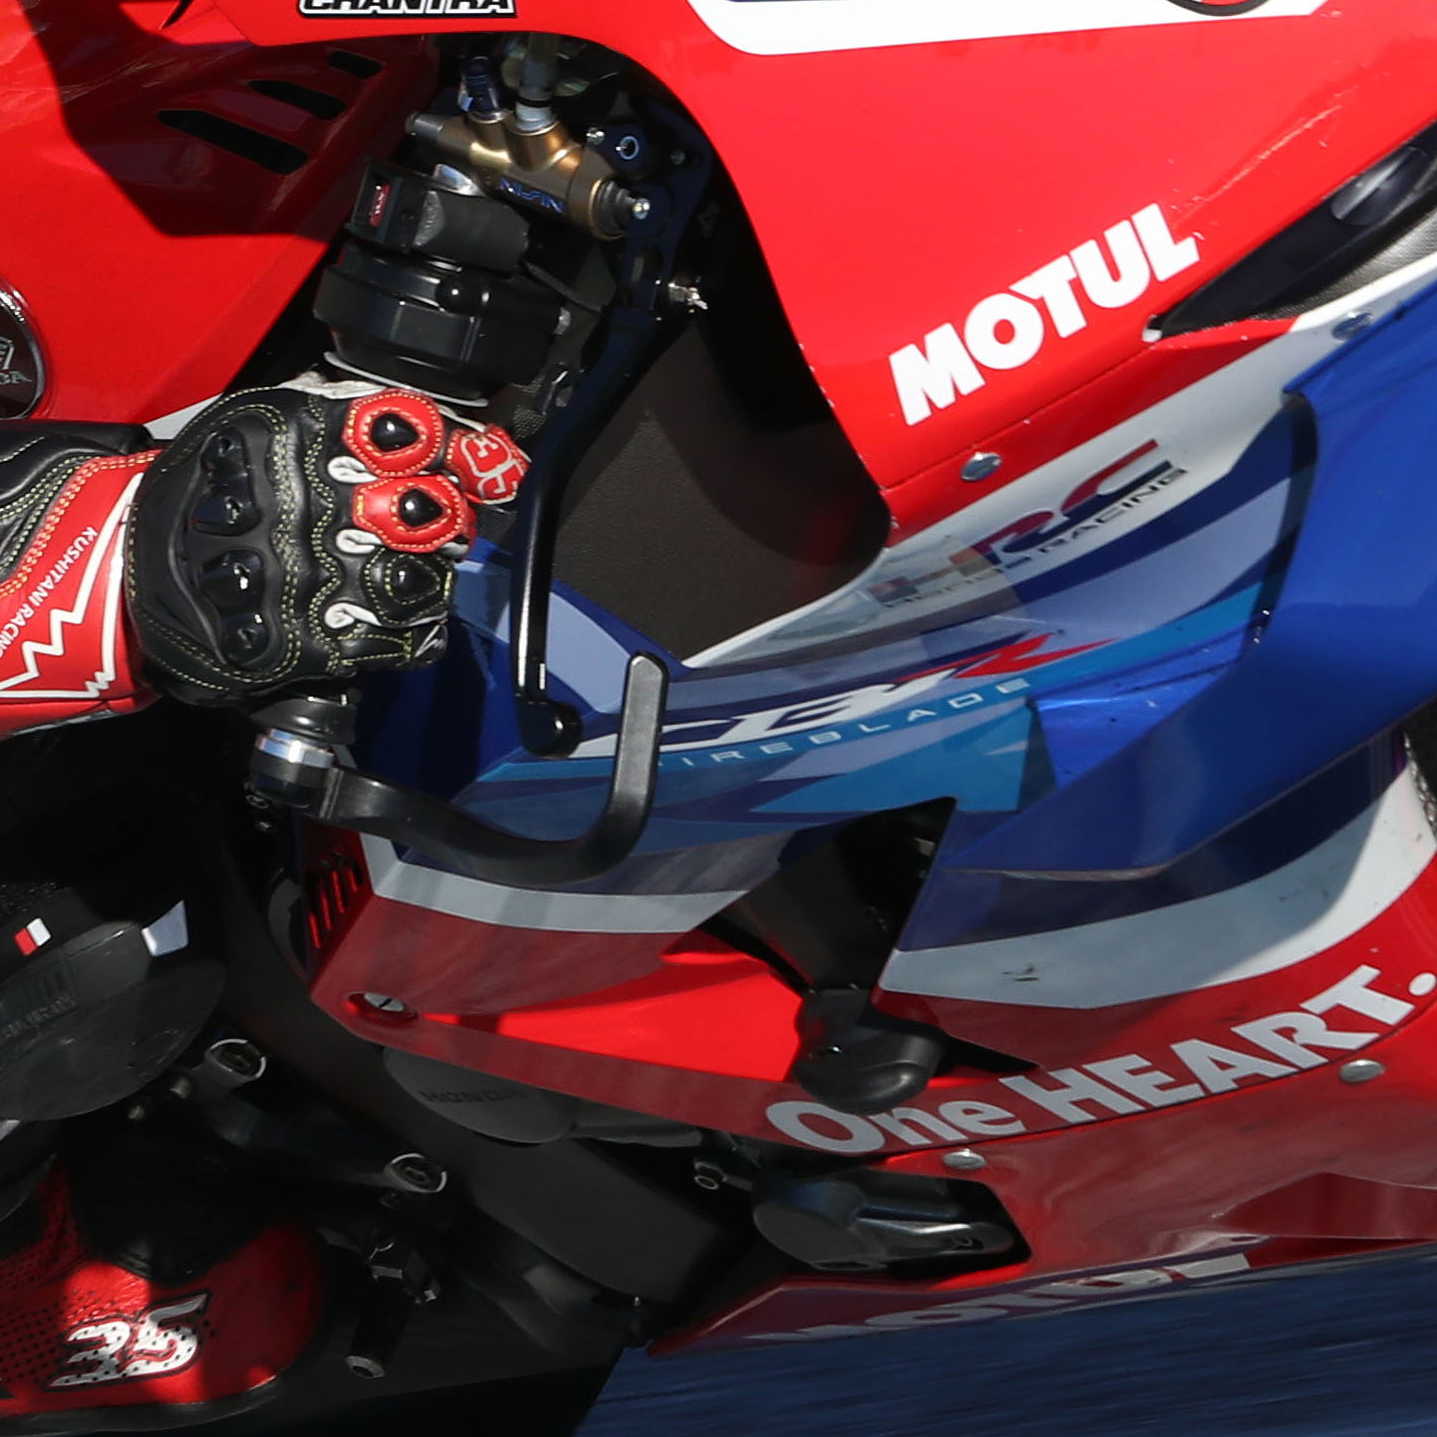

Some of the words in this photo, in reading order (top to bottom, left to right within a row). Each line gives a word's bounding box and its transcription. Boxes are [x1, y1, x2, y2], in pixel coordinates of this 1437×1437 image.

[889, 203, 1200, 427] MOTUL
[1038, 466, 1189, 554] RACING
[28, 526, 98, 607] KUSHITANI
[662, 677, 1032, 766] IREBLADE
[766, 1099, 1027, 1155] One
[998, 964, 1437, 1127] HEART.
[49, 1292, 212, 1391] 35
